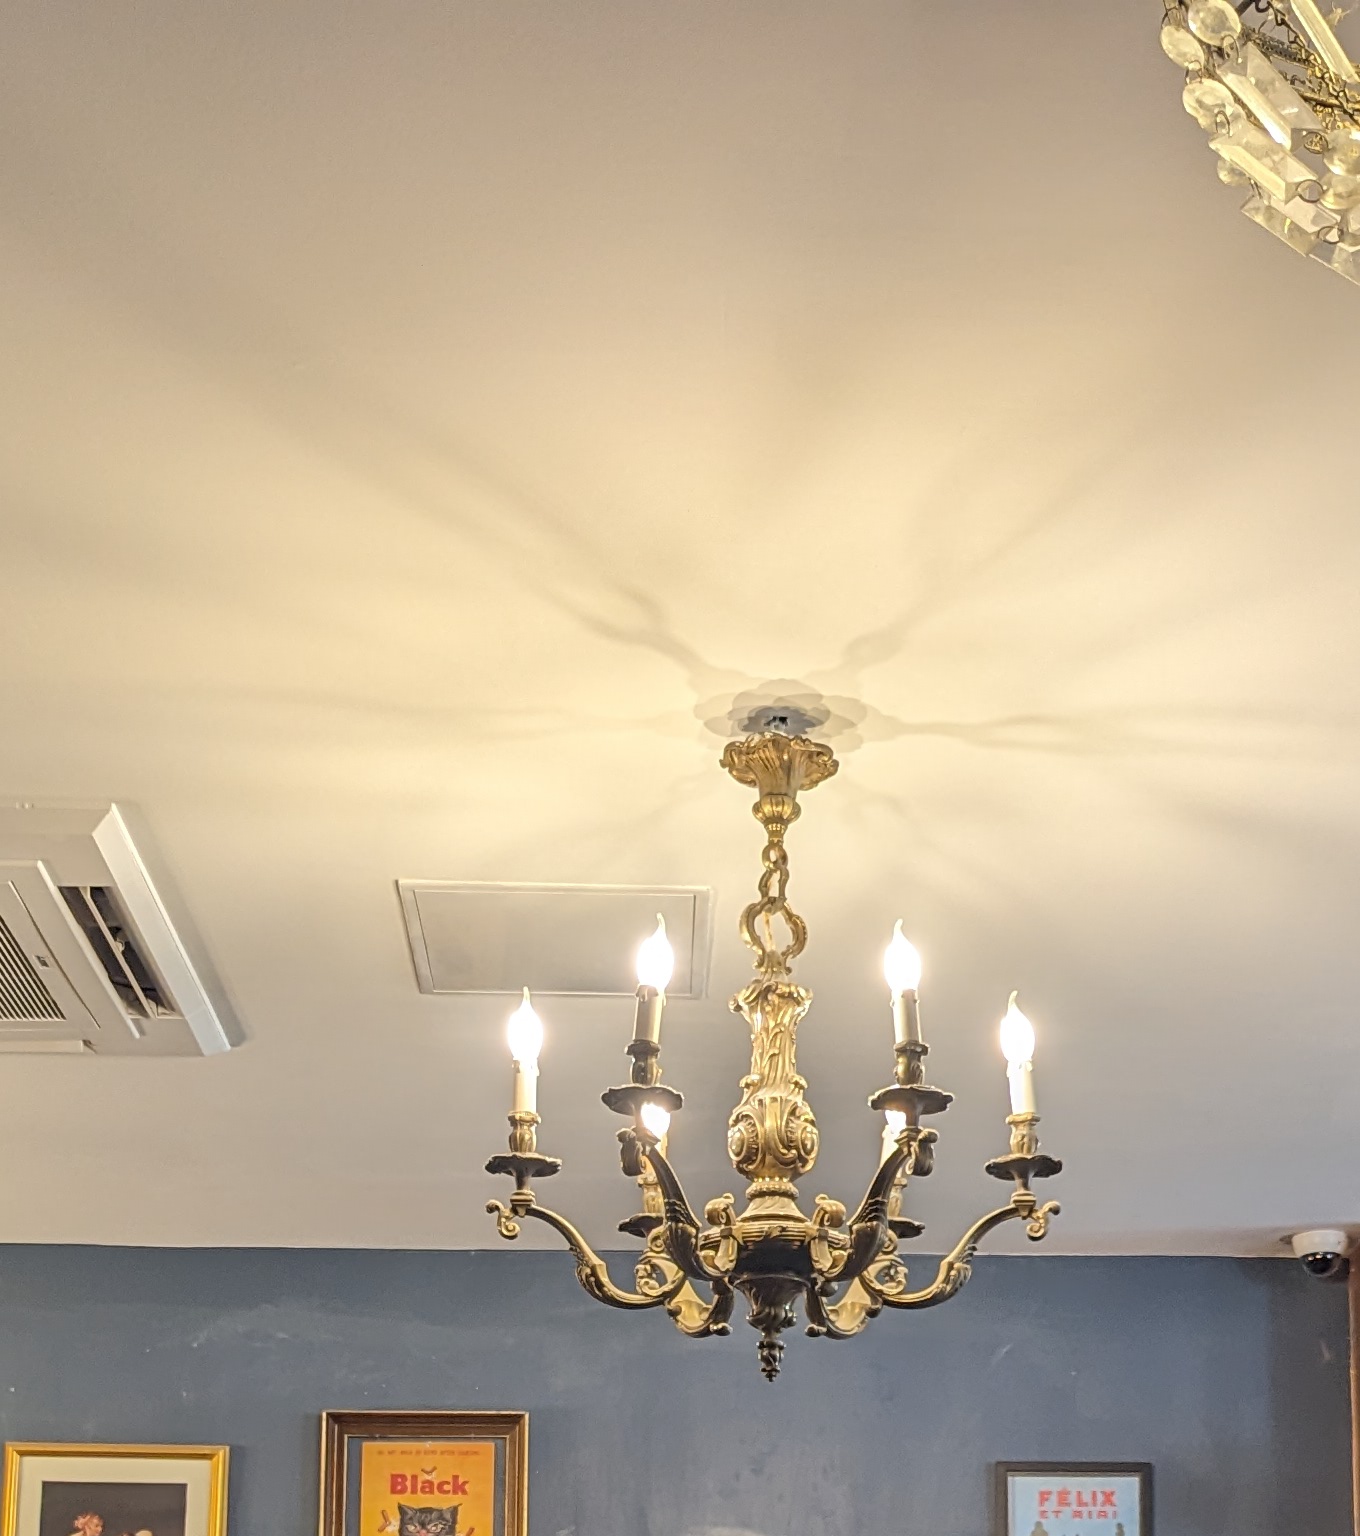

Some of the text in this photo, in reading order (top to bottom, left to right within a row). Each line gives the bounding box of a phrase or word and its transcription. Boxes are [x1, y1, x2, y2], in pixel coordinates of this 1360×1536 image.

[389, 1473, 469, 1495] Black
[1038, 1487, 1117, 1507] FÉLIX
[1039, 1510, 1063, 1519] ET
